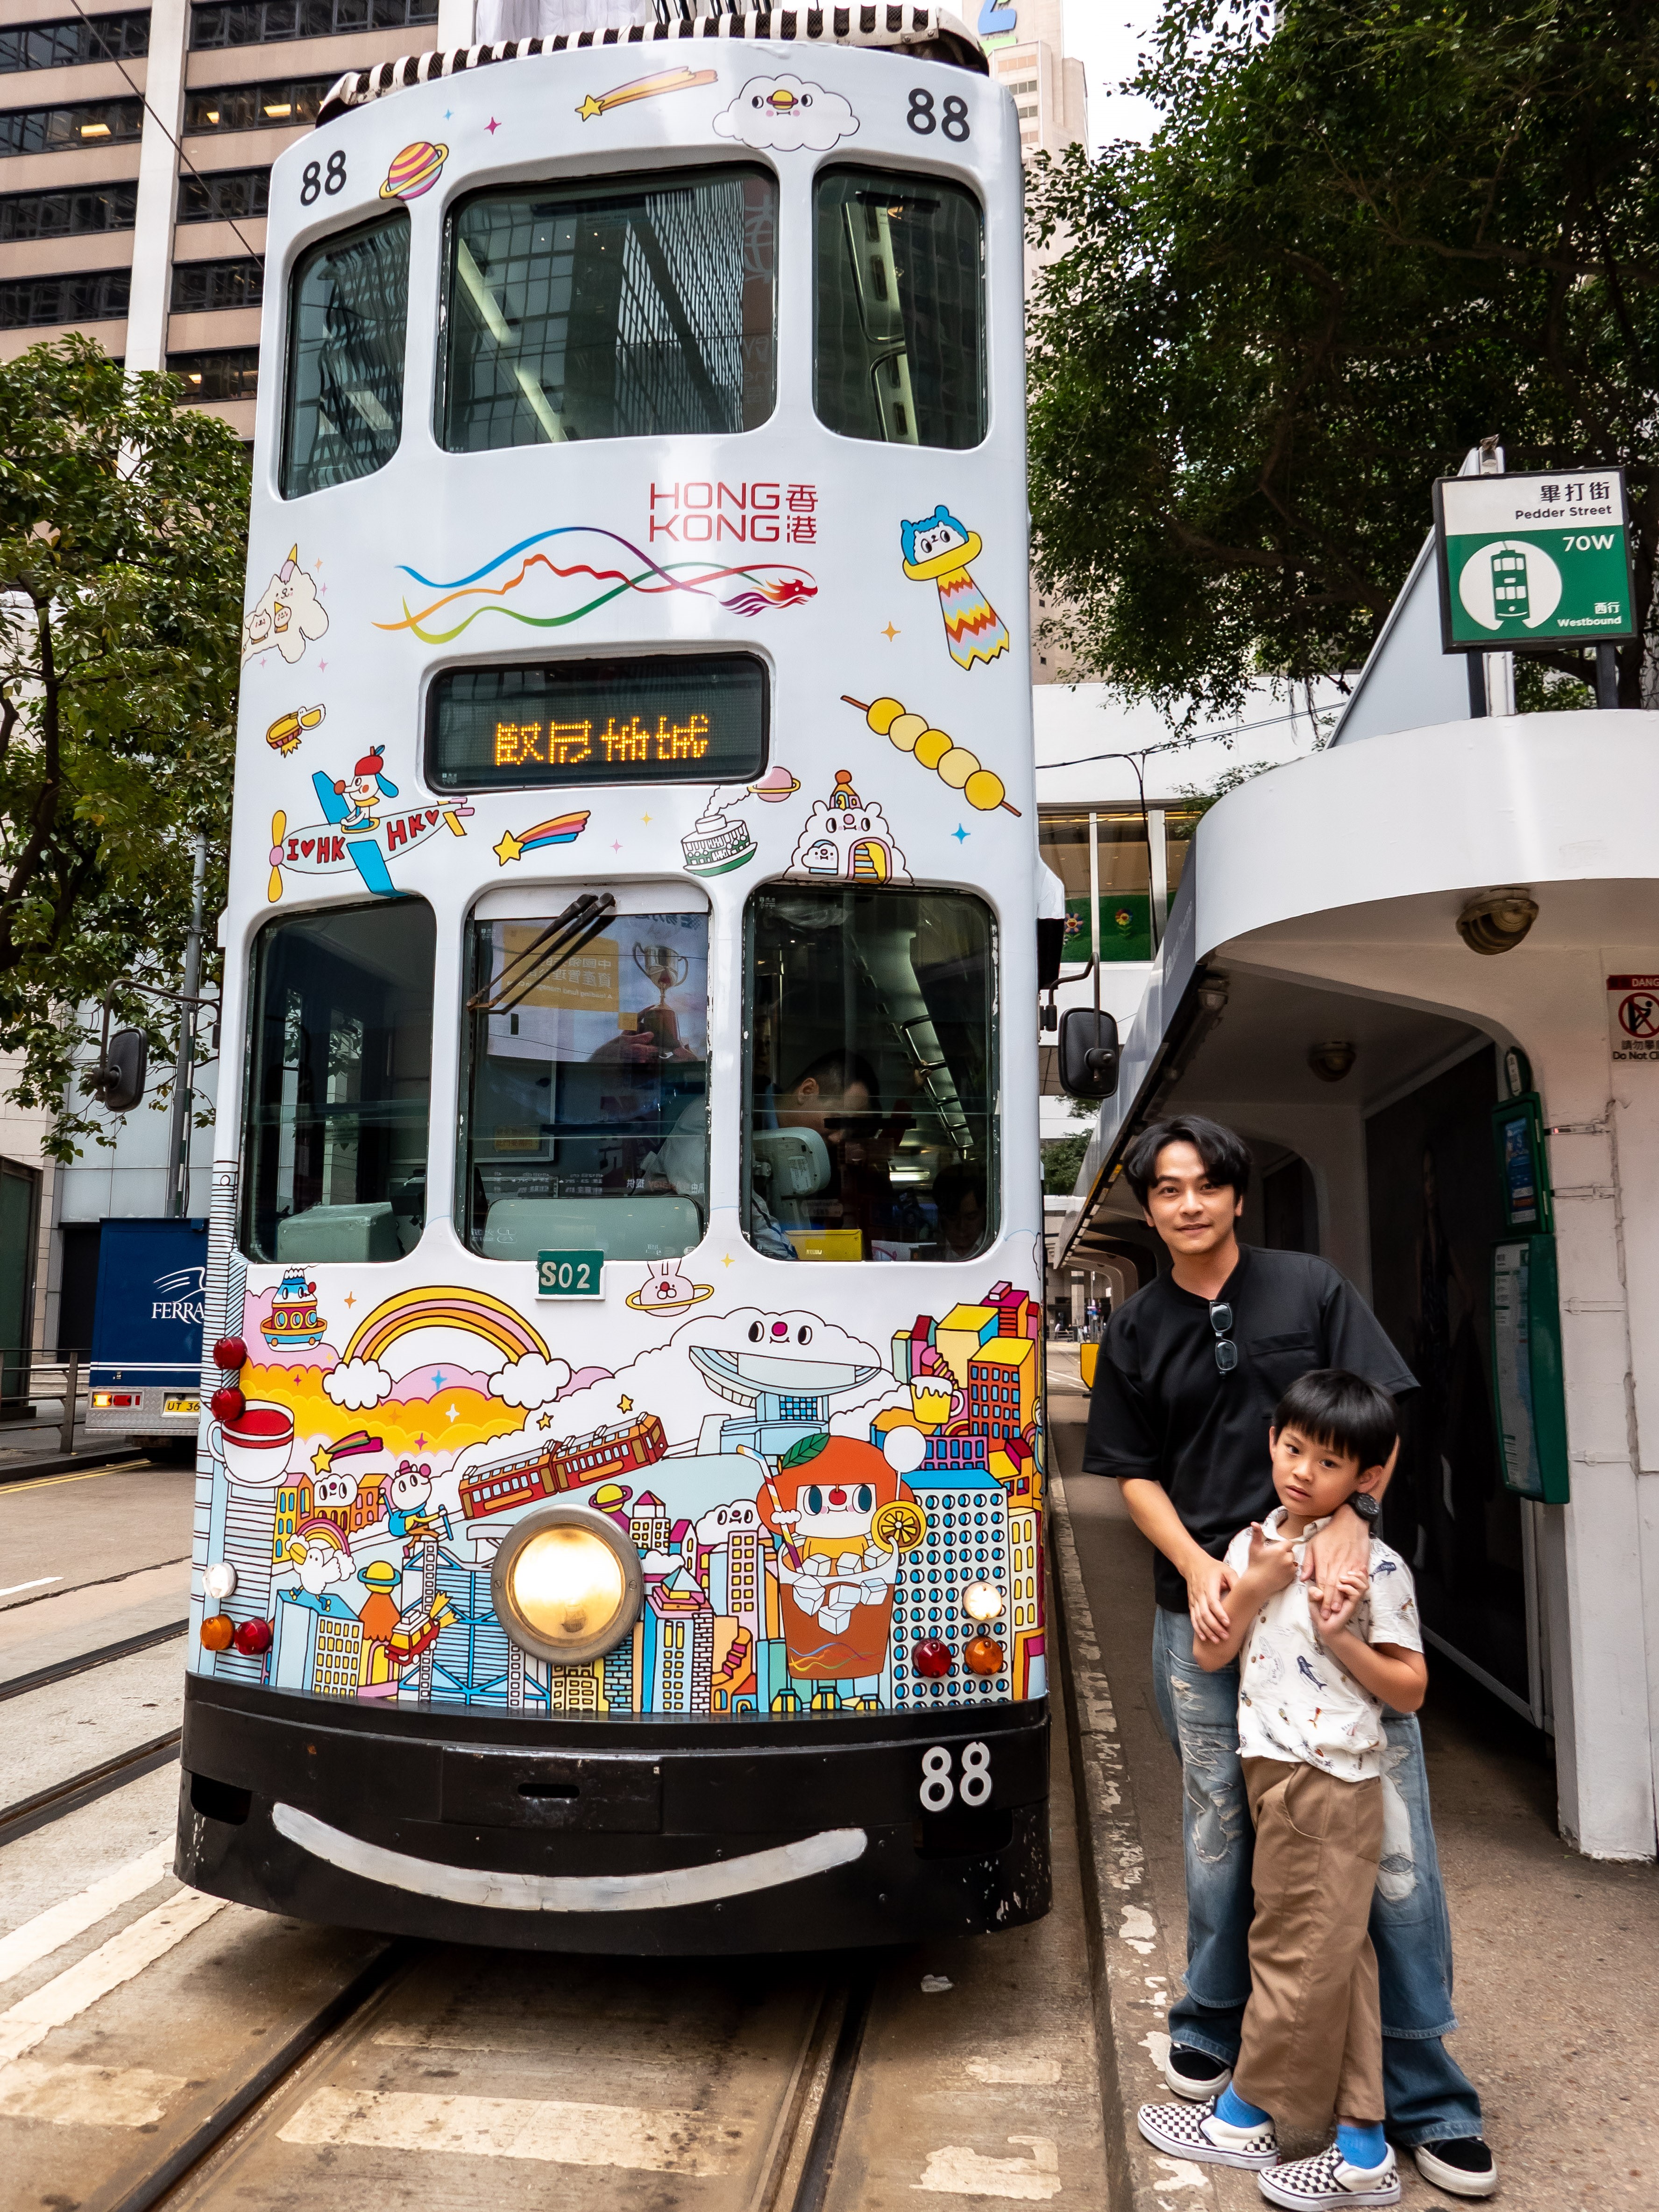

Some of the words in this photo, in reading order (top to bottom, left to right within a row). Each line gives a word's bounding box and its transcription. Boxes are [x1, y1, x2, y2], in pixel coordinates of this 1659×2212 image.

[906, 87, 971, 142] 88
[300, 150, 347, 207] 88
[649, 482, 780, 511] HONG
[1539, 482, 1611, 503] 畢打街
[785, 483, 819, 545] 香港
[1515, 508, 1565, 520] Pedder
[1569, 505, 1612, 517] Street
[648, 514, 780, 544] KONG
[1563, 534, 1615, 552] 70W
[1557, 615, 1622, 627] Westbound
[1594, 601, 1620, 615] 西行
[386, 813, 427, 852] HK
[287, 837, 299, 862] I
[317, 836, 346, 865] HK
[1613, 1051, 1627, 1060] Do
[1629, 1051, 1648, 1060] Not
[540, 1261, 591, 1289] S02
[167, 1402, 182, 1411] UT
[919, 1741, 993, 1812] 88
